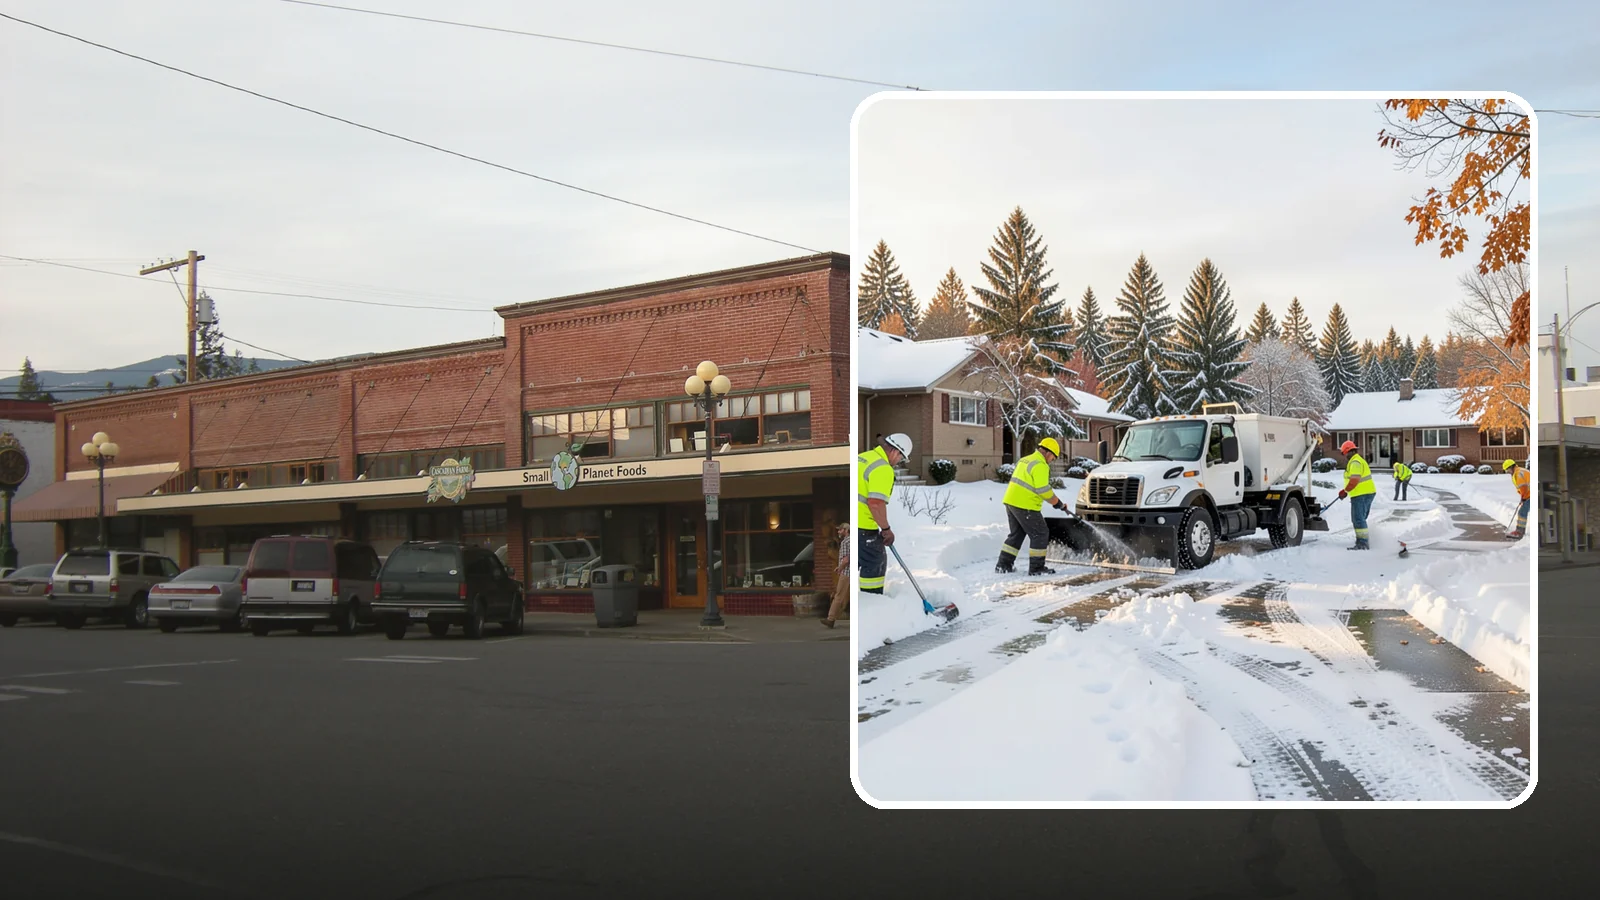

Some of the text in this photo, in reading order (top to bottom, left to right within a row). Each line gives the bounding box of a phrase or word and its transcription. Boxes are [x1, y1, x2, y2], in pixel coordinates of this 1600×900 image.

[523, 464, 647, 483] Small Planet Foods
